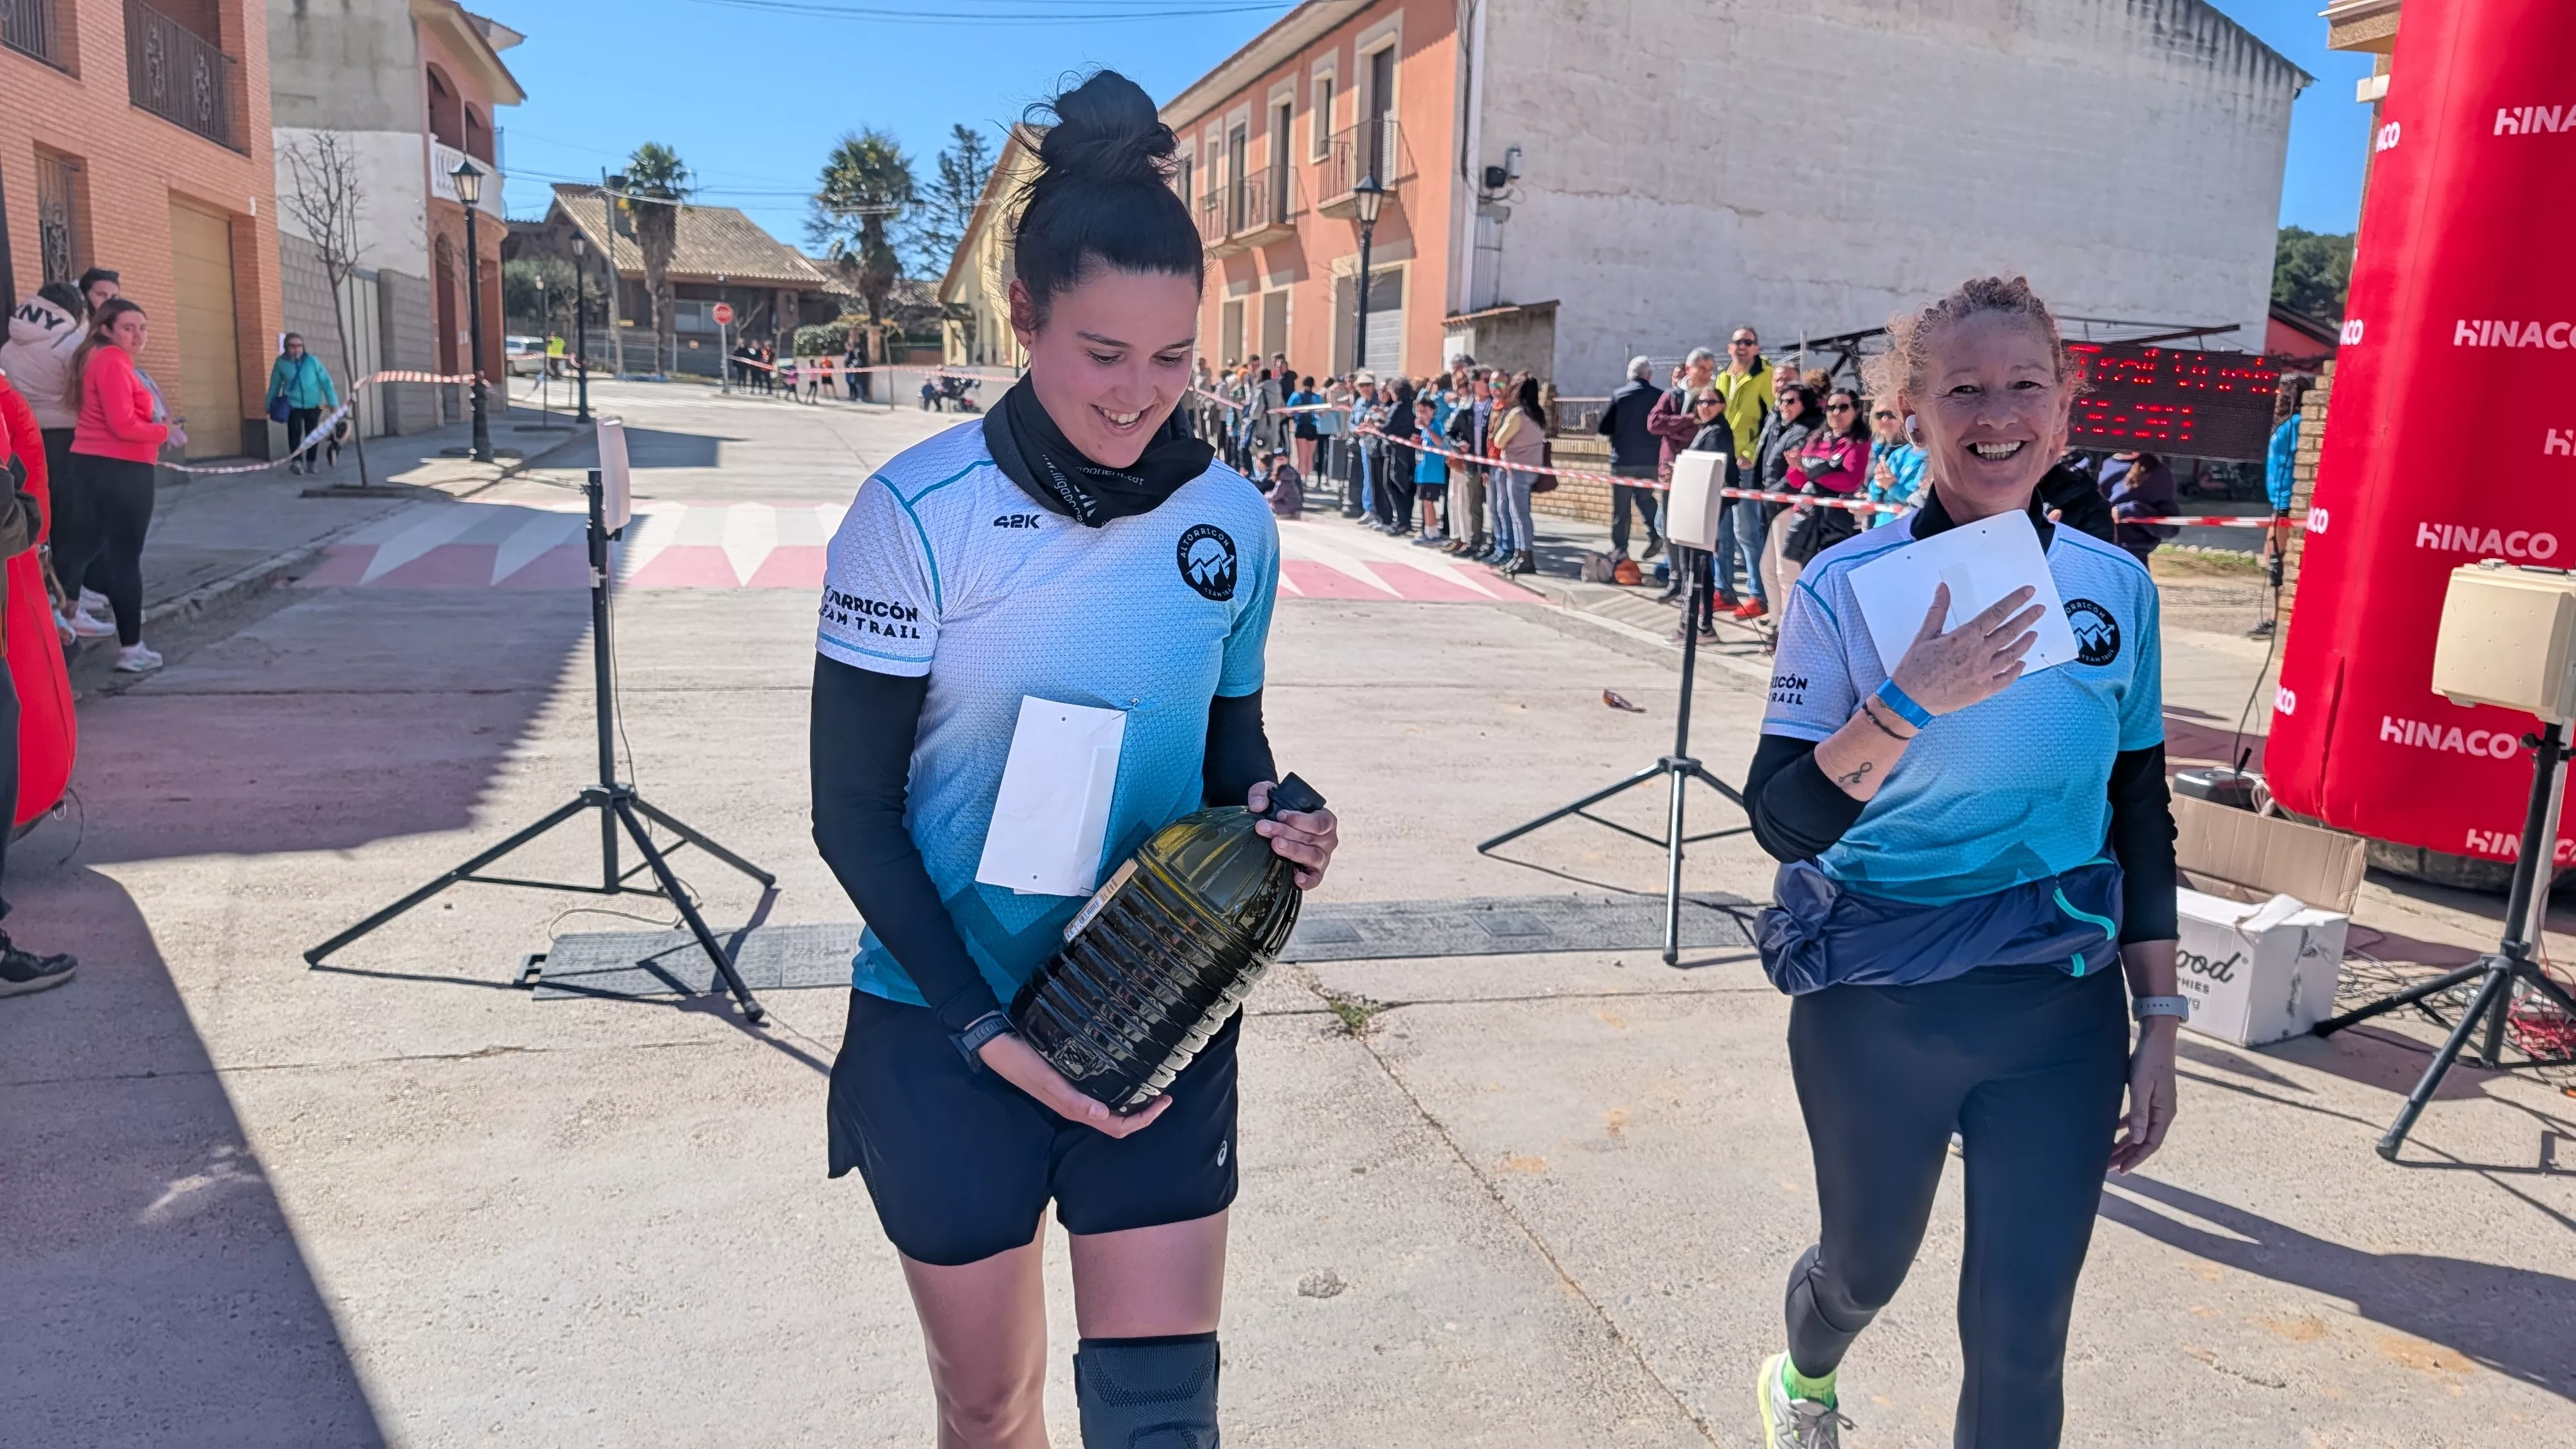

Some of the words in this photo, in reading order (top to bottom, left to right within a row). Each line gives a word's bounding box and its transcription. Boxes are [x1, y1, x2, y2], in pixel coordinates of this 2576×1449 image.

[2453, 319, 2576, 350] HINAC
[993, 514, 1041, 530] 42K
[2416, 509, 2558, 560] HINACO
[1180, 528, 1229, 559] ALTORRICÓN
[1204, 587, 1222, 597] TEAM
[855, 617, 921, 639] TRAIL
[2082, 654, 2101, 663] TEAM
[2101, 649, 2114, 661] TRAIL
[2380, 715, 2518, 760] HINACO
